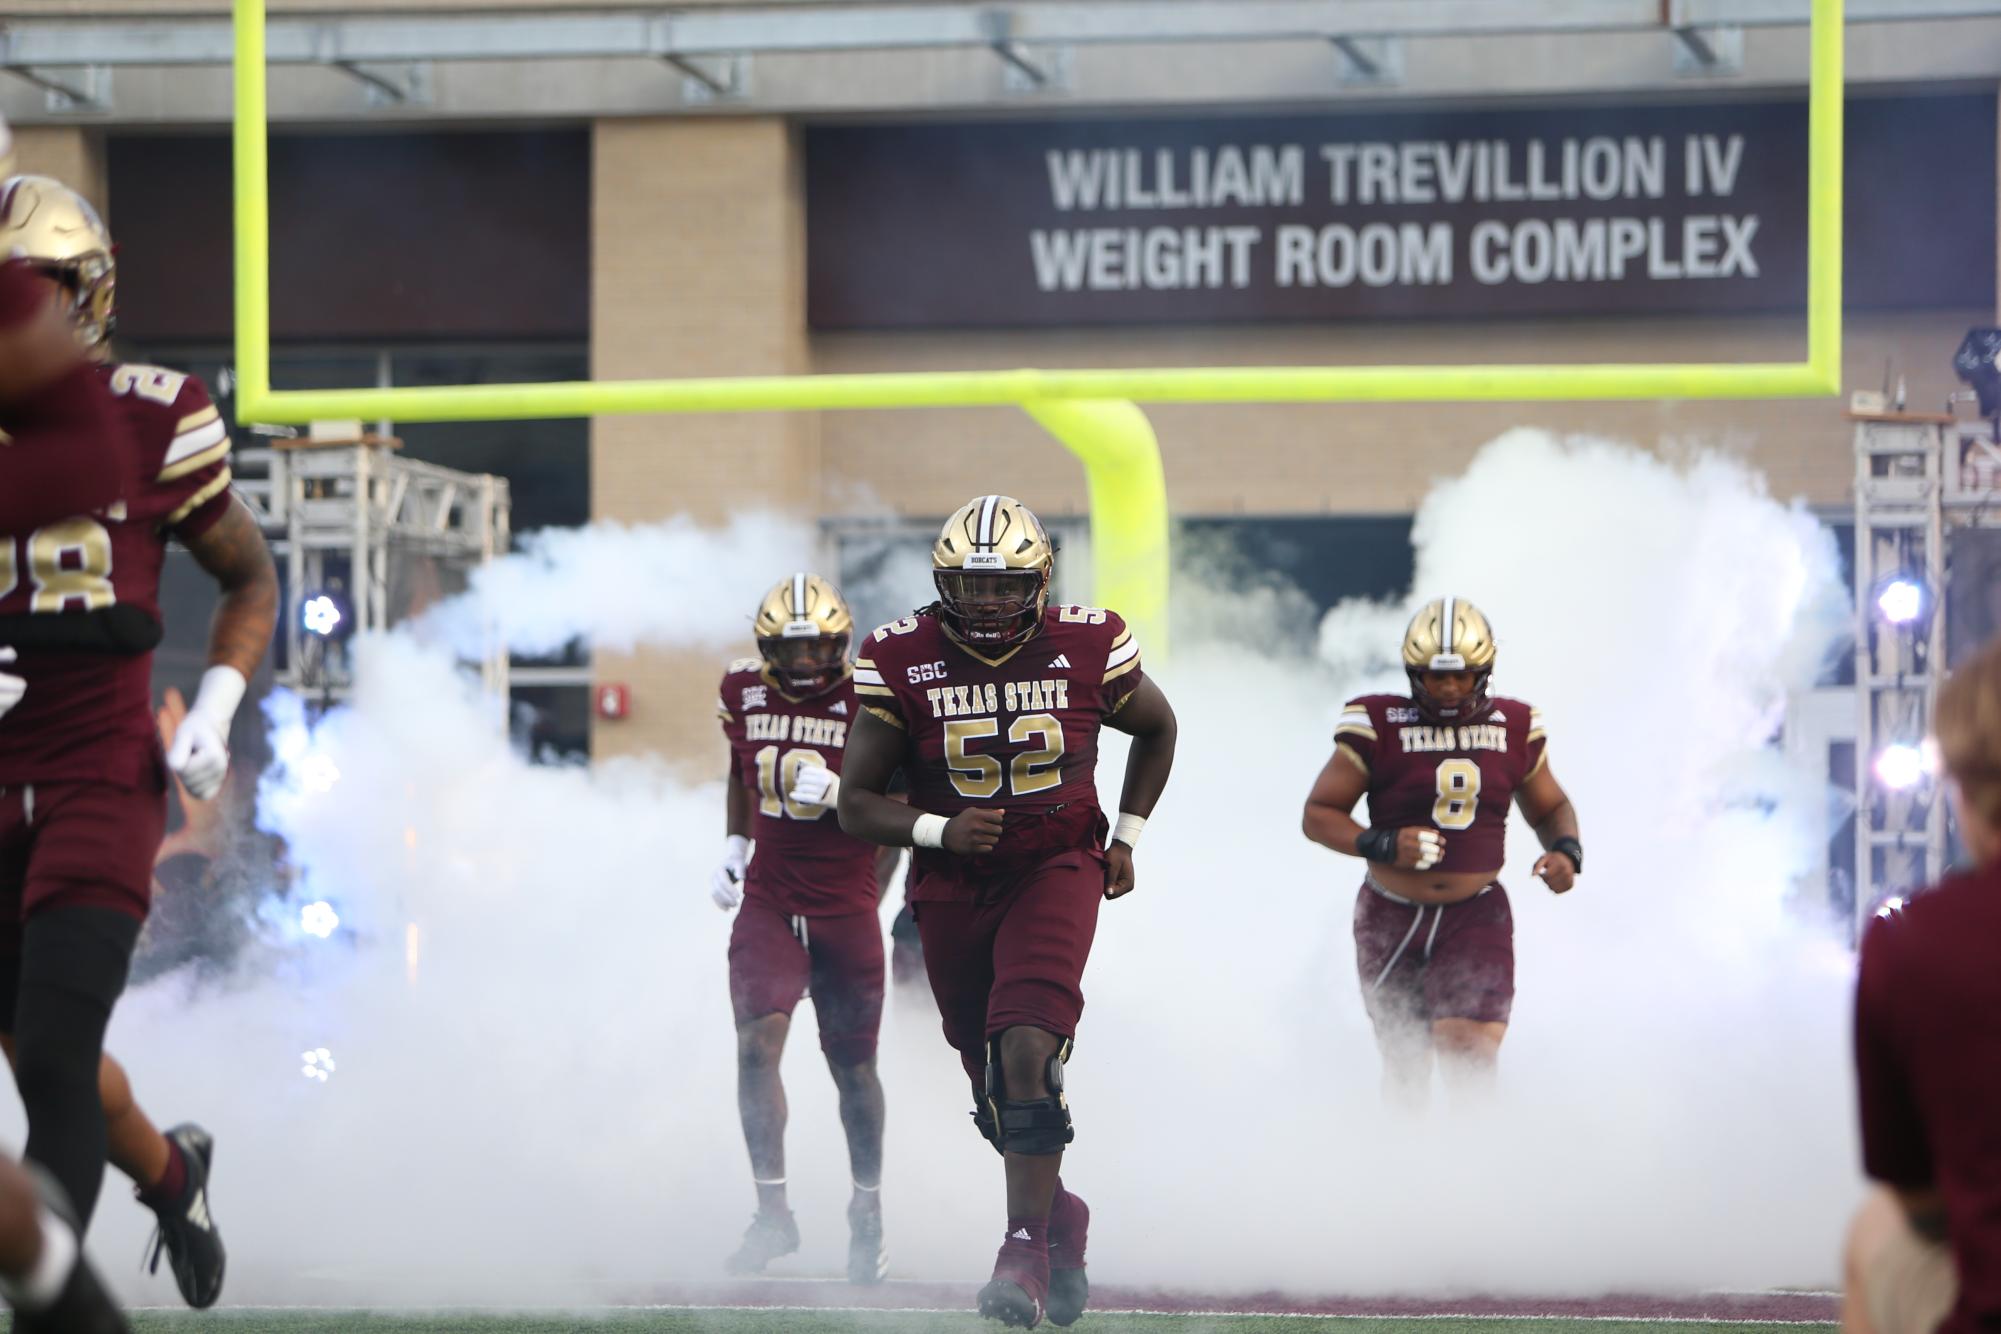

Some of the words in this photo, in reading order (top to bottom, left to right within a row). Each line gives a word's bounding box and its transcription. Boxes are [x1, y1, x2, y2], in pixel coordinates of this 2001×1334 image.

[1047, 144, 1304, 211] WILLIAM
[1321, 137, 1665, 206] TREVILLION
[1684, 134, 1743, 196] IV
[1030, 226, 1260, 291] WEIGHT
[1275, 221, 1453, 288] ROOM
[1469, 215, 1759, 282] COMPLEX
[0, 516, 116, 613] 8
[971, 556, 997, 564] BOBCATS
[907, 660, 948, 685] SBC
[927, 683, 998, 718] TEXAS
[1004, 679, 1069, 712] STATE
[792, 716, 847, 748] STATE
[943, 712, 1066, 799] 52
[1399, 726, 1456, 753] TEXAS
[1458, 724, 1507, 753] STATE
[1432, 758, 1482, 831] 8
